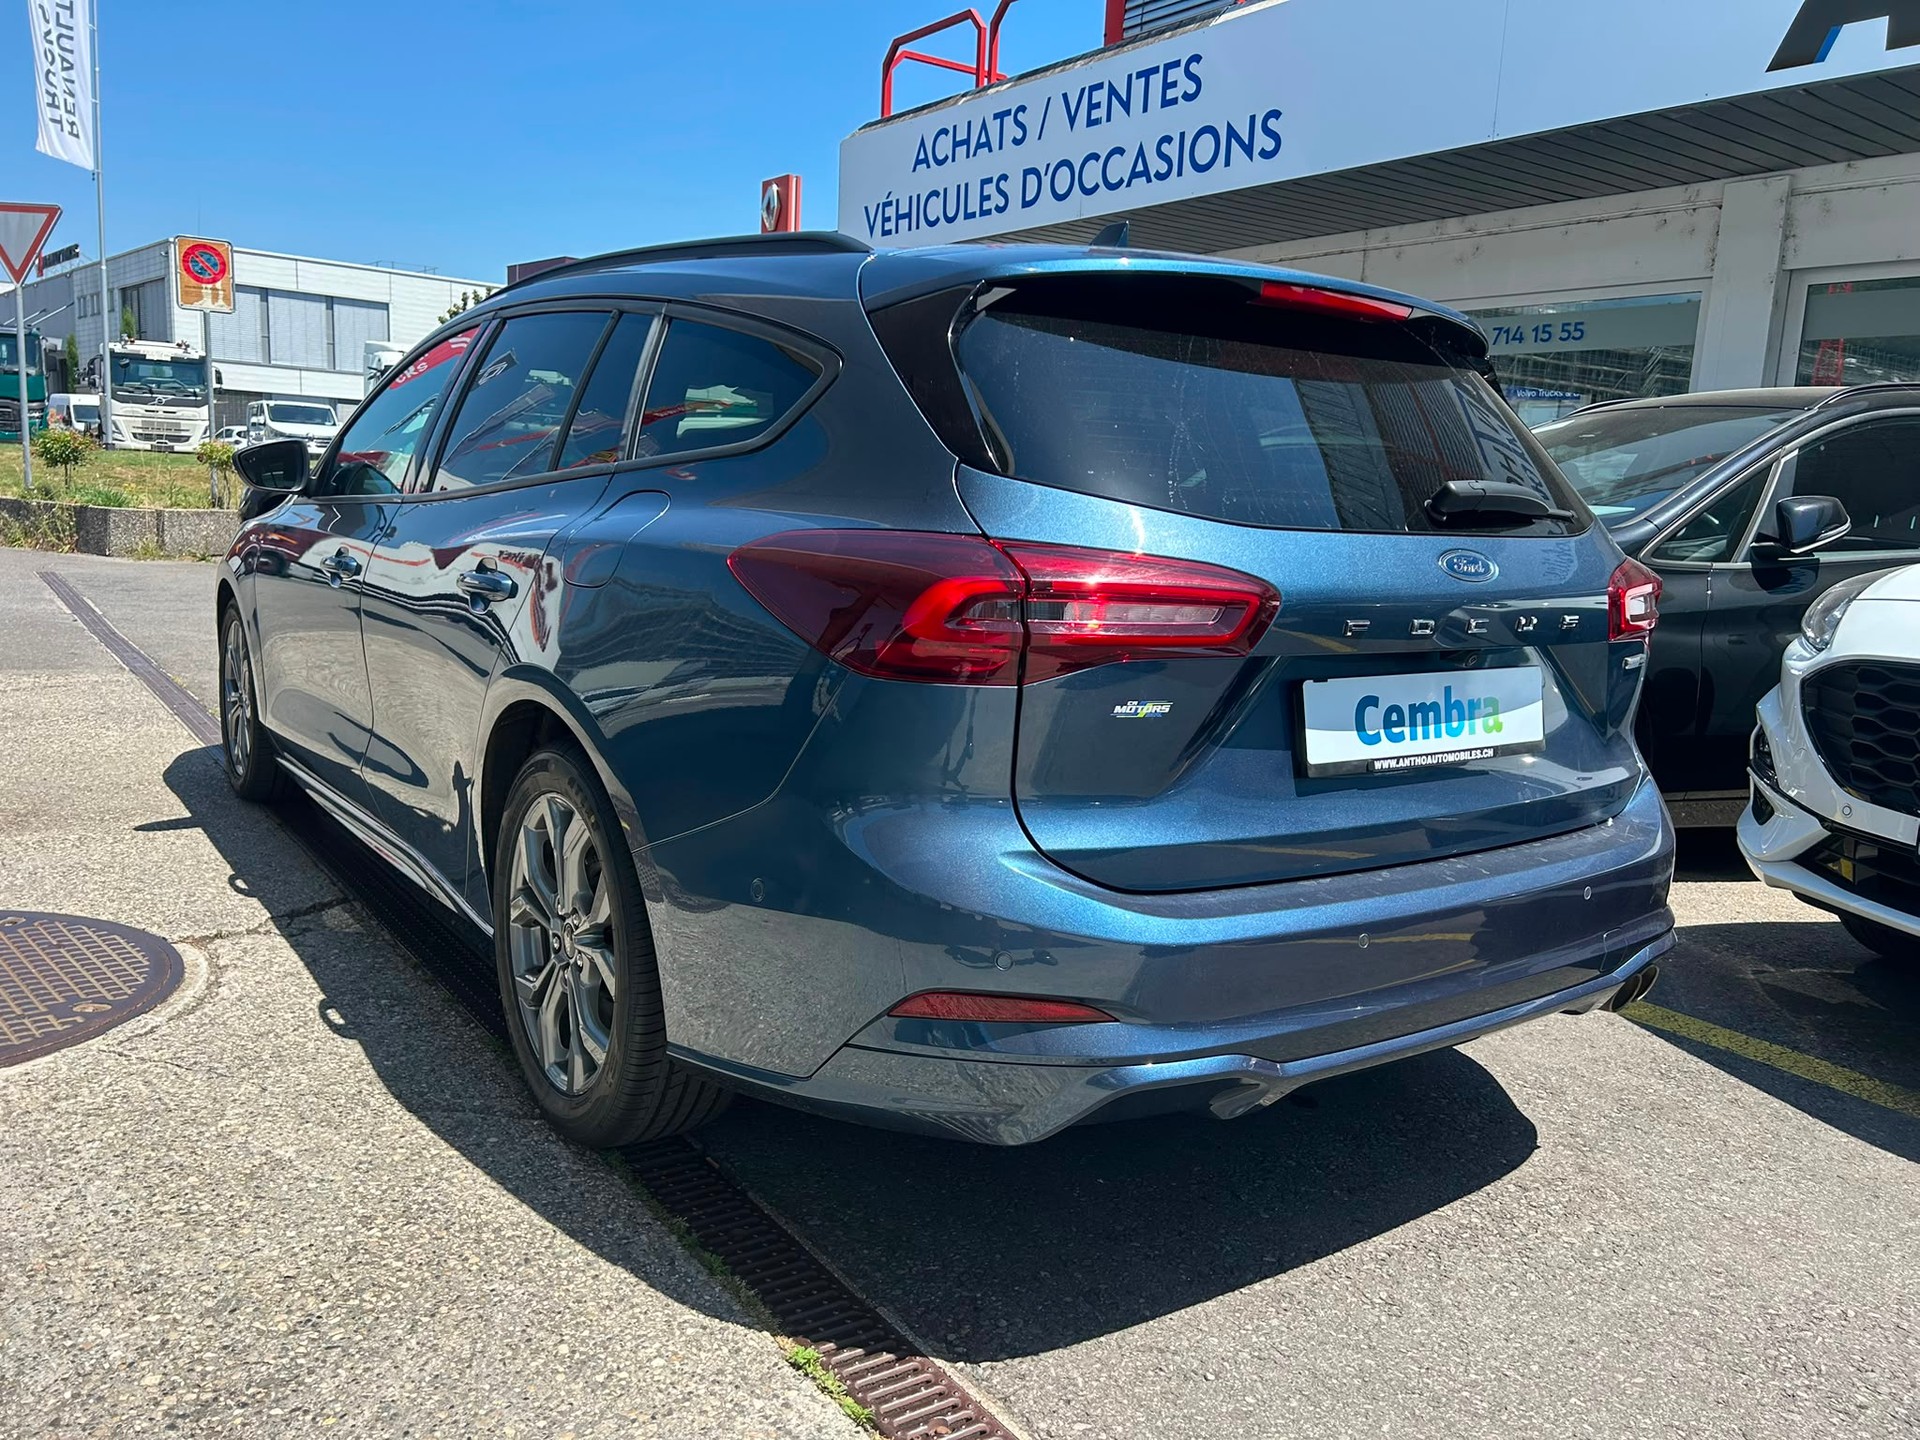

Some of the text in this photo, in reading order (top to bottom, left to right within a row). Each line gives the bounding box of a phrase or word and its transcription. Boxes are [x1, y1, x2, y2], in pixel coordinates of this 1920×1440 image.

[911, 104, 1028, 173] ACHATS
[1061, 53, 1203, 132] VENTES
[863, 109, 1283, 239] VÉHICULES D'OCCASIONS
[1492, 321, 1585, 345] 714 15 55
[1516, 389, 1537, 398] Volvo
[1453, 557, 1486, 574] Ford
[1343, 614, 1580, 637] FOCUS
[1113, 705, 1171, 713] MOTORS
[1354, 685, 1503, 746] Cembra
[1374, 748, 1494, 770] WWW.ANTHOAUTOMOBILES.CH
